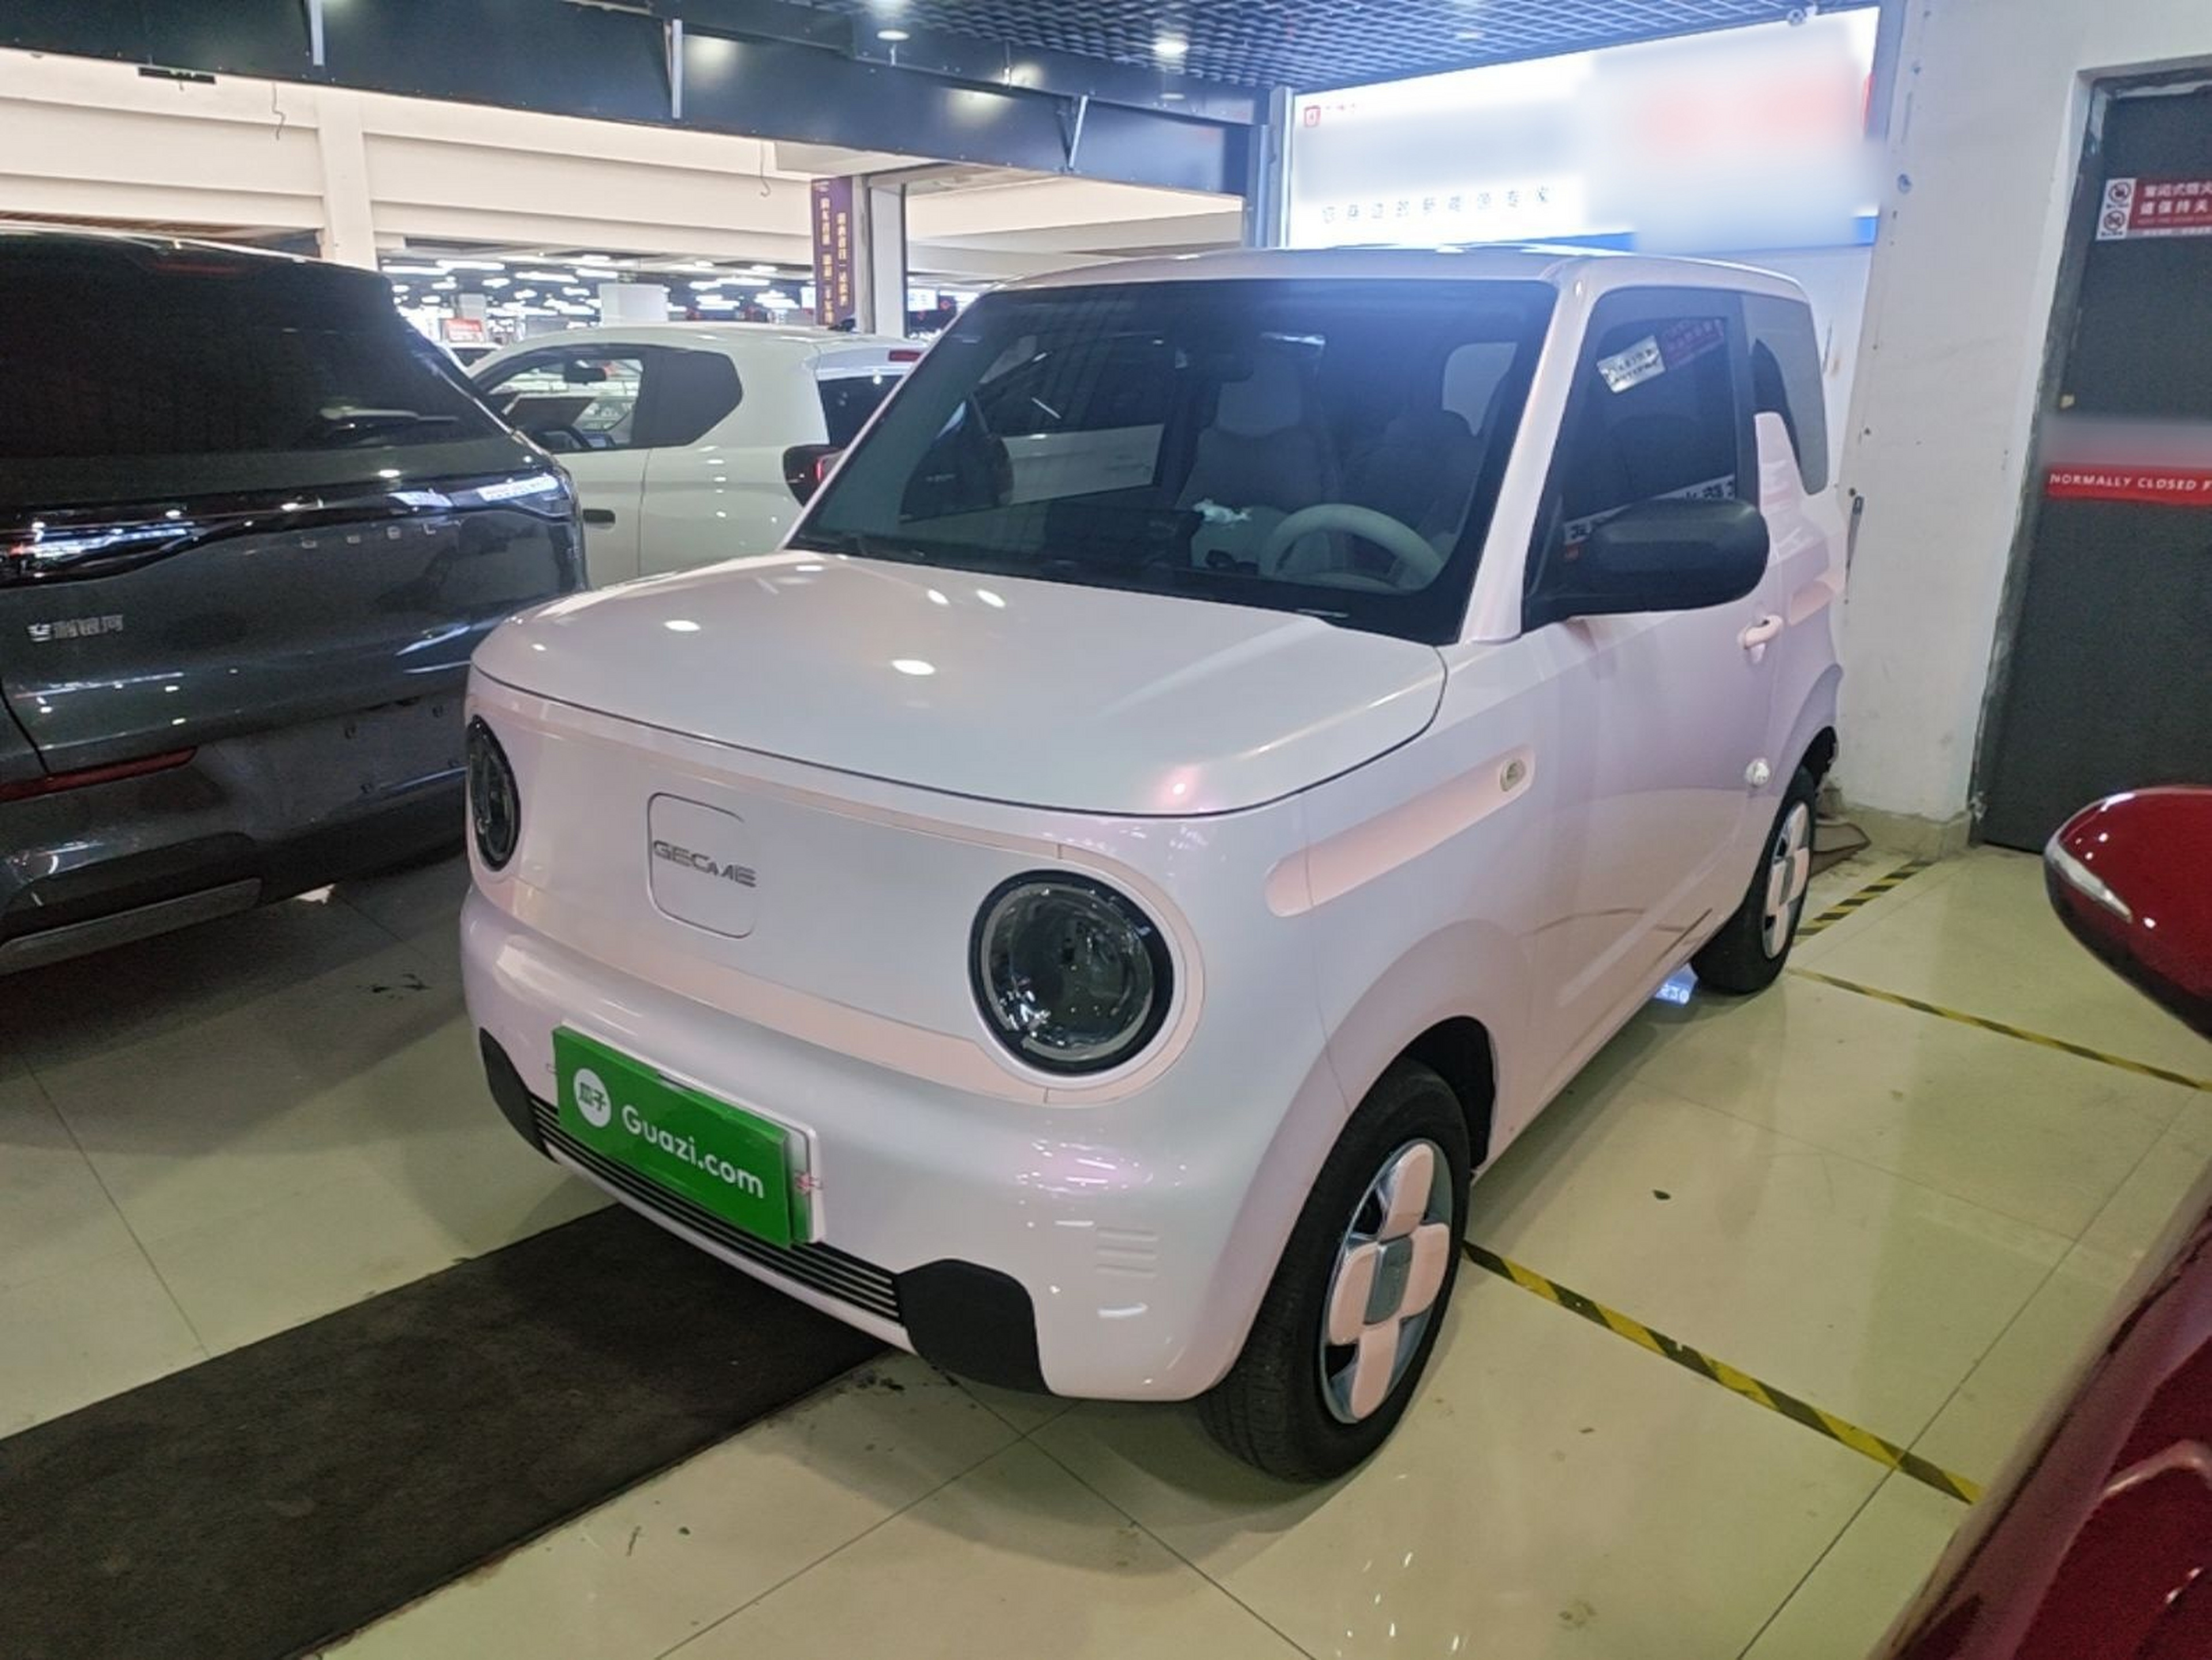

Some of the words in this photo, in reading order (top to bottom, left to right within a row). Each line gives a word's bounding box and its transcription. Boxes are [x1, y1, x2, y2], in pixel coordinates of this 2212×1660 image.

[2050, 474, 2133, 487] NORMALLY
[2138, 477, 2197, 490] CLOSED
[622, 1104, 764, 1199] Guazi.com
